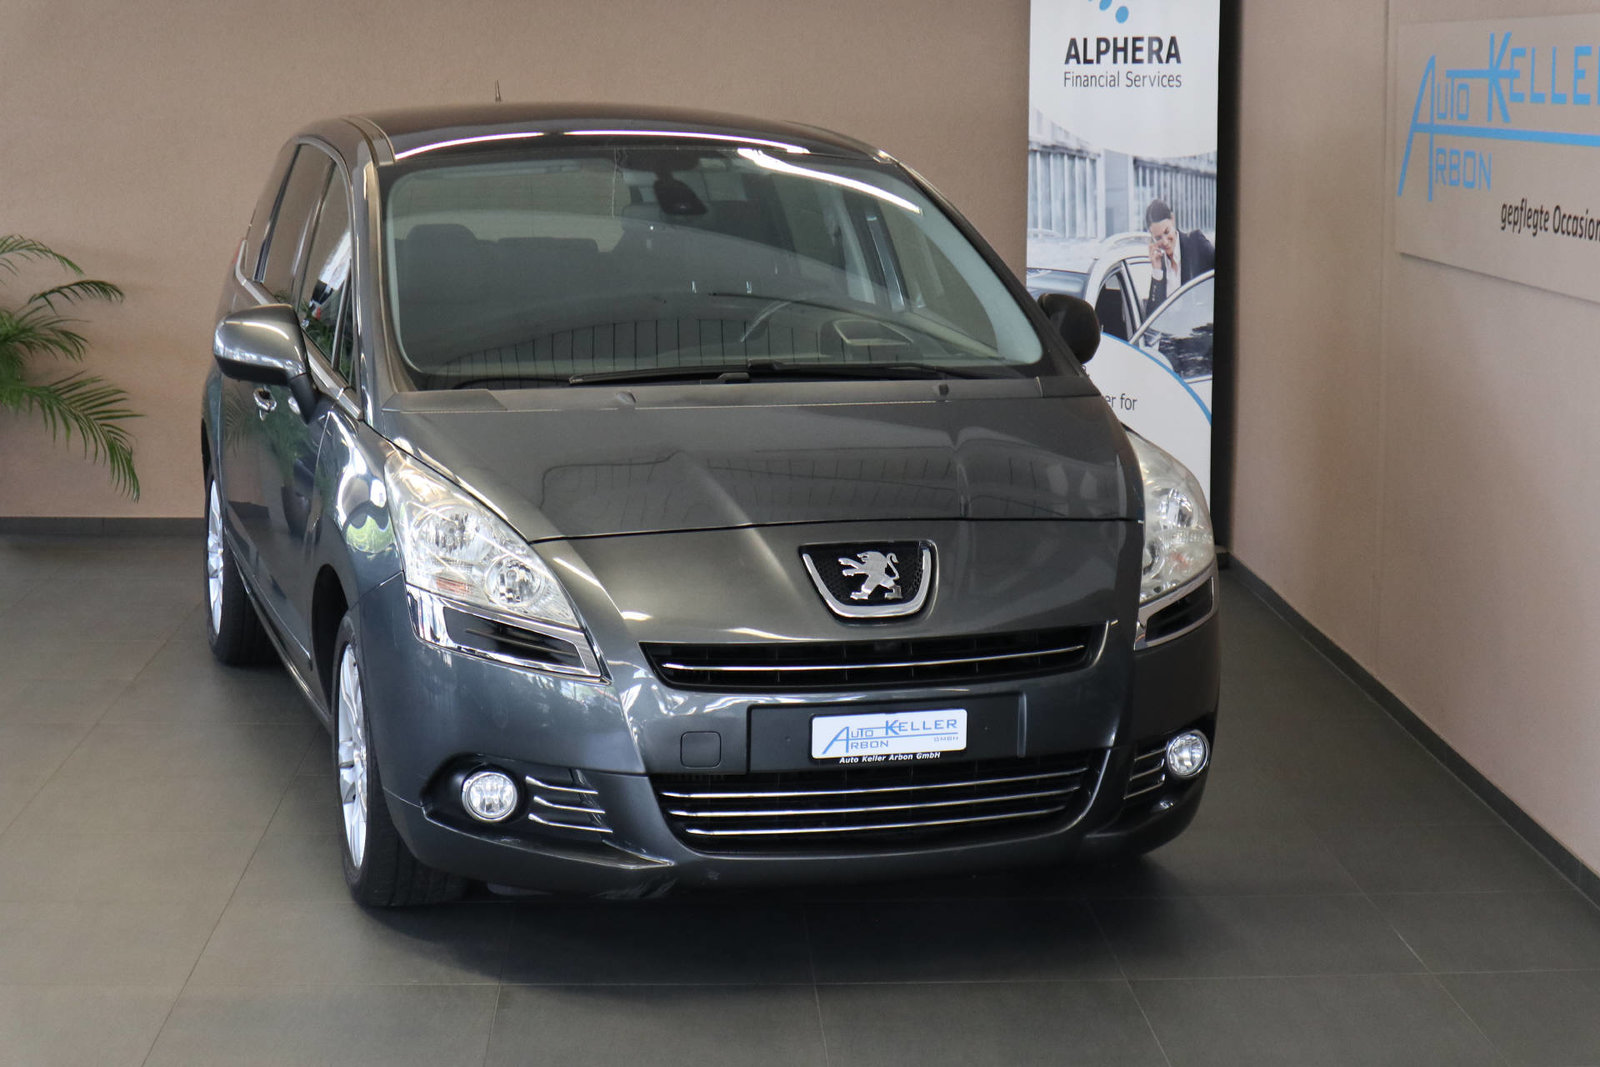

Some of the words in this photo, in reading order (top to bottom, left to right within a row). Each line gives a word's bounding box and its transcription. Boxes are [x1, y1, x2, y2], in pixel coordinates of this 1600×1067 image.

[1064, 36, 1182, 65] ALPHERA
[1063, 71, 1120, 88] Financial
[1125, 71, 1182, 88] Services
[1487, 32, 1600, 123] KELLE
[1501, 198, 1549, 237] gepflegte
[1120, 393, 1137, 411] for
[885, 719, 959, 736] KELLER
[839, 756, 859, 764] Auto
[862, 754, 886, 763] Keller
[889, 753, 913, 761] Arbon
[916, 751, 941, 760] GmbH
